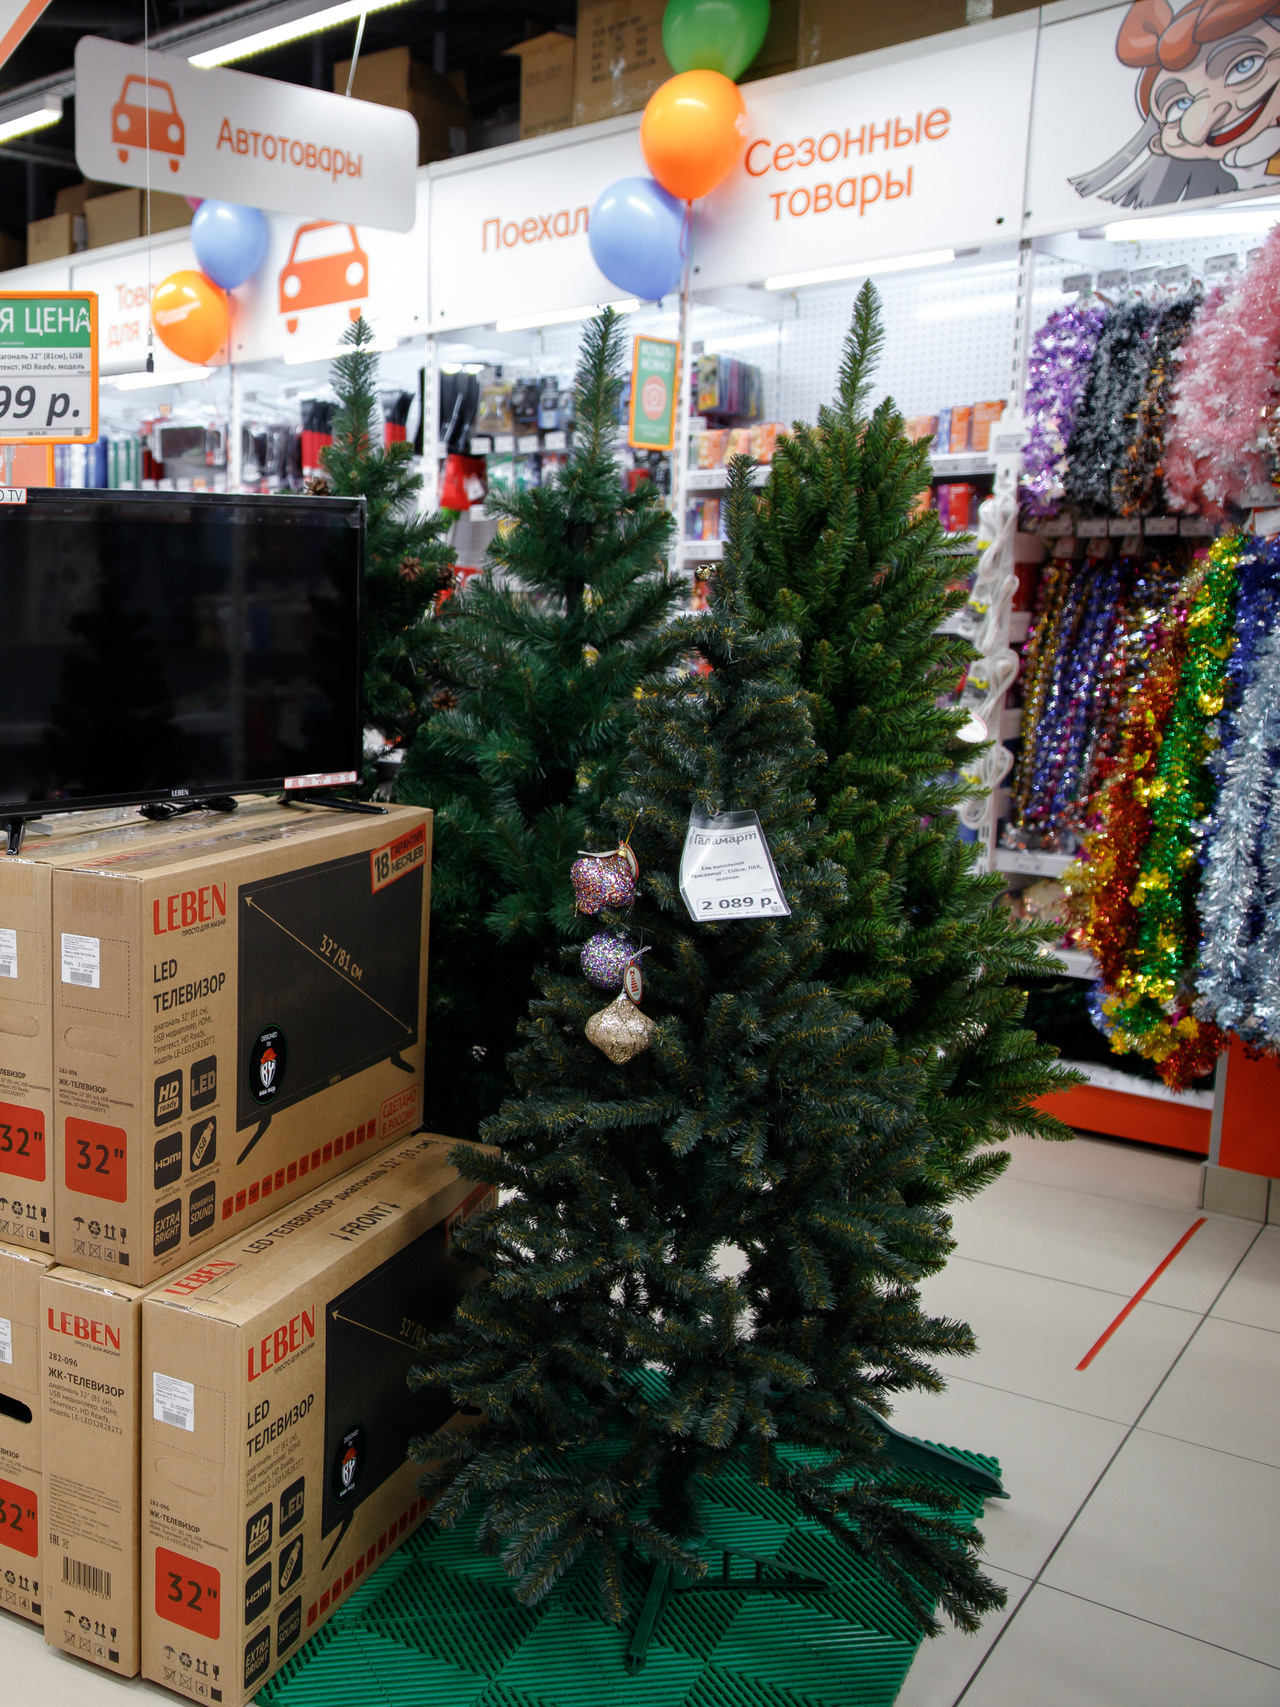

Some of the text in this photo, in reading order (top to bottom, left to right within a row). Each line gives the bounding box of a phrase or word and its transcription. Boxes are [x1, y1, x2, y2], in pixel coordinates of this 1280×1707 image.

[217, 117, 362, 184] Автотовары
[744, 106, 951, 176] Сезонные
[769, 165, 913, 220] товары
[482, 204, 589, 254] Поехал
[25, 307, 91, 336] ЦЕНА
[30, 352, 42, 360] 32"
[69, 352, 83, 360] USB
[58, 363, 85, 371] модель
[45, 391, 81, 427] р.
[8, 489, 23, 502] TV
[172, 789, 189, 797] LEBEN
[391, 829, 423, 857] ГАРАНТИЯ
[694, 832, 757, 845] Галамарт
[375, 852, 390, 882] 18
[391, 844, 424, 874] МЕСЯЦЕВ
[153, 882, 226, 935] LEBEN
[701, 901, 713, 910] 2
[718, 896, 754, 909] 089
[153, 959, 178, 984] LED
[153, 972, 226, 1013] ТЕЛЕВИЗОР
[59, 1077, 107, 1094] ЖК-ТЕЛЕВИЗОР
[159, 1080, 180, 1103] HD
[192, 1070, 215, 1097] LED
[159, 1100, 178, 1112] ready
[382, 1088, 417, 1118] СДЕЛАНО
[0, 1123, 43, 1157] 32"
[195, 1136, 207, 1160] USB
[76, 1139, 124, 1175] 32"
[155, 1210, 180, 1233] EXTRA
[191, 1204, 214, 1225] SOUND
[242, 1237, 275, 1254] LED
[267, 1199, 337, 1239] ТЕЛЕВИЗОР
[334, 1169, 389, 1200] диагональ
[340, 1206, 394, 1237] FRONT
[155, 1224, 180, 1246] BRIGHT
[164, 1259, 237, 1297] LEBEN
[48, 1308, 120, 1350] LEBEN
[248, 1304, 315, 1383] LEBEN
[48, 1352, 78, 1367] 282-096
[48, 1367, 125, 1398] ЖК-ТЕЛЕВИЗОР
[48, 1382, 79, 1396] диагональ
[48, 1390, 61, 1399] USB
[80, 1408, 89, 1416] HD
[246, 1393, 314, 1458] ТЕЛЕВИЗОР
[247, 1399, 270, 1430] LED
[149, 1509, 201, 1533] ЖК-ТЕЛЕВИЗОР
[281, 1491, 304, 1525] LED
[250, 1514, 270, 1542] HD
[284, 1557, 294, 1581] USB
[167, 1572, 218, 1613] 32"
[245, 1637, 269, 1668] EXTRA
